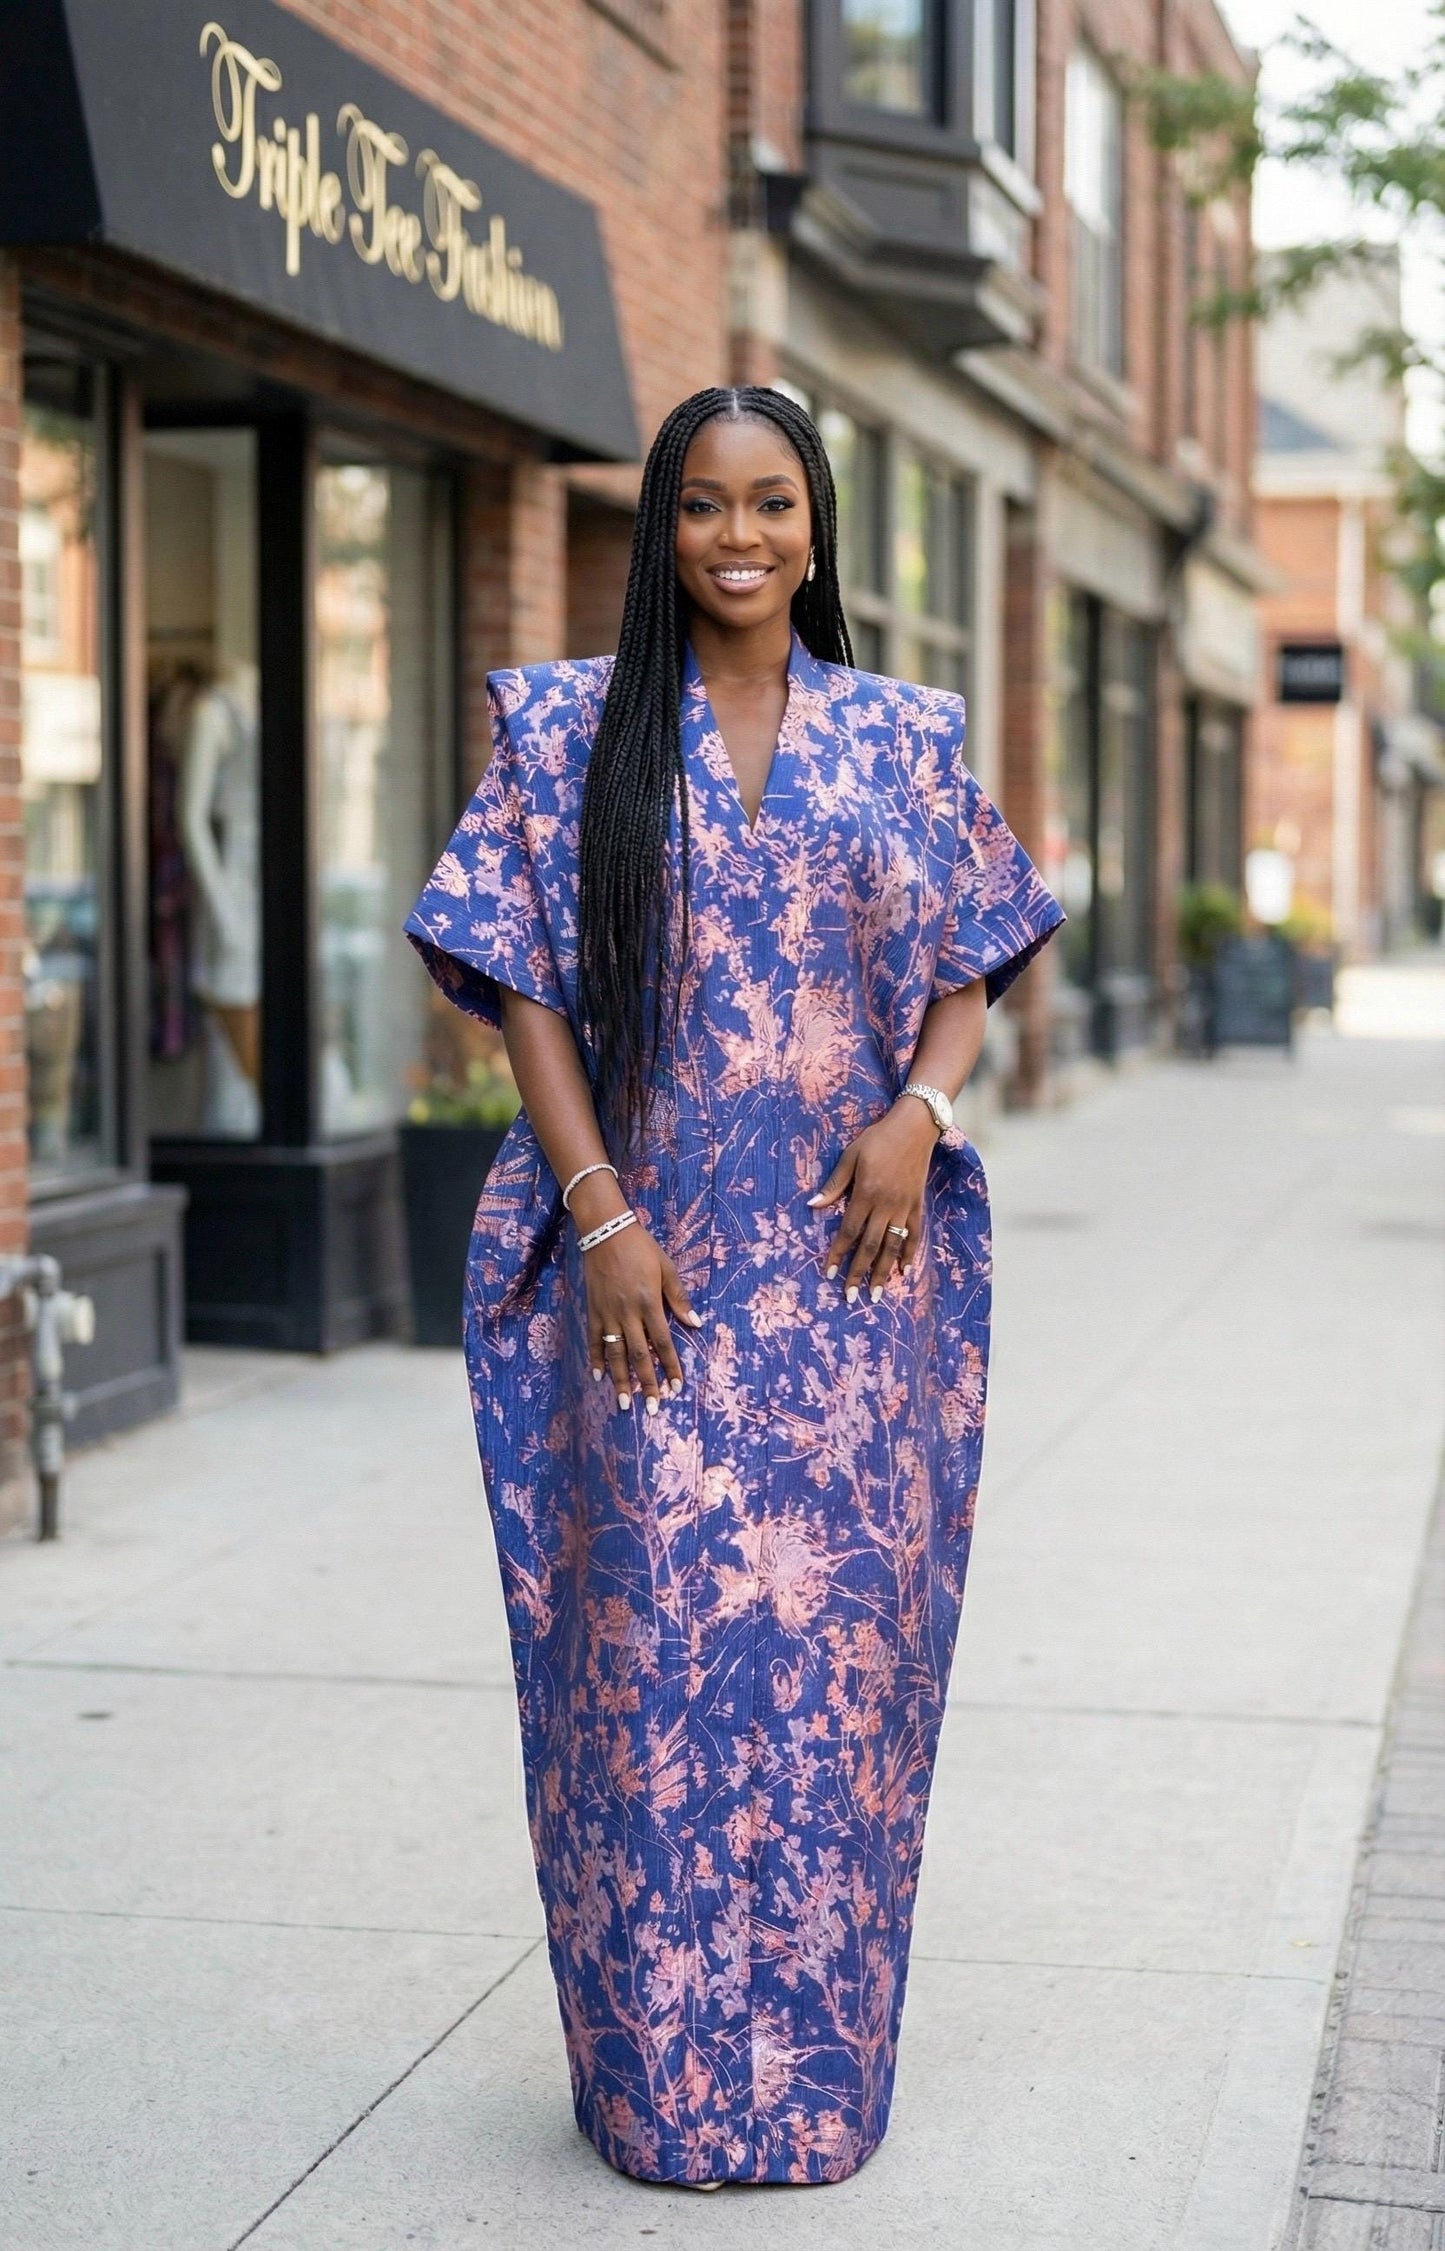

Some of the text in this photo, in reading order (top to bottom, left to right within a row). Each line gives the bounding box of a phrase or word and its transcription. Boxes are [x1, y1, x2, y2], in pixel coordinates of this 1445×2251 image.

[200, 22, 564, 353] Triple Tee Fashion
